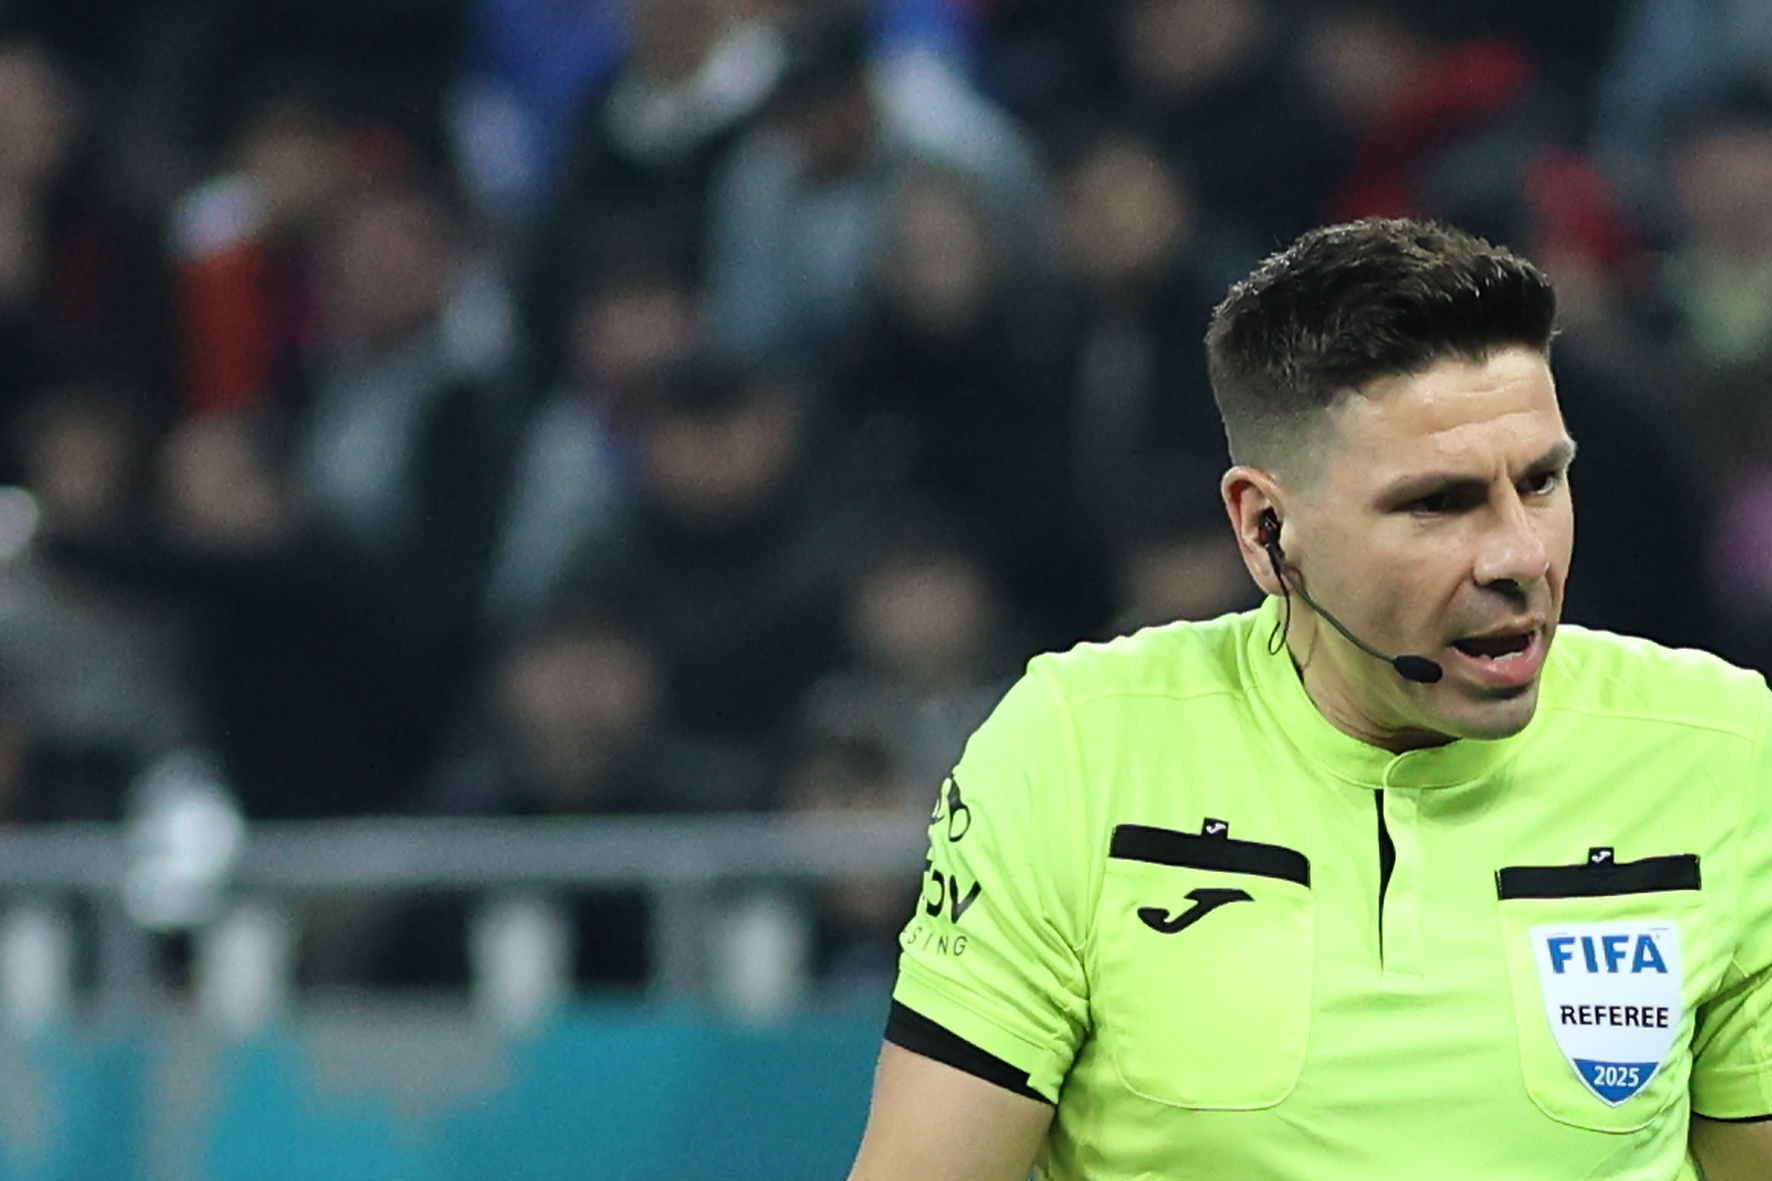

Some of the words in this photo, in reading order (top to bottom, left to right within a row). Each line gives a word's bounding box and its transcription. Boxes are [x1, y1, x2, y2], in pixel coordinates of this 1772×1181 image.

[1546, 934, 1668, 974] FIFA
[1560, 1005, 1669, 1029] REFEREE
[1594, 1064, 1640, 1088] 2025
